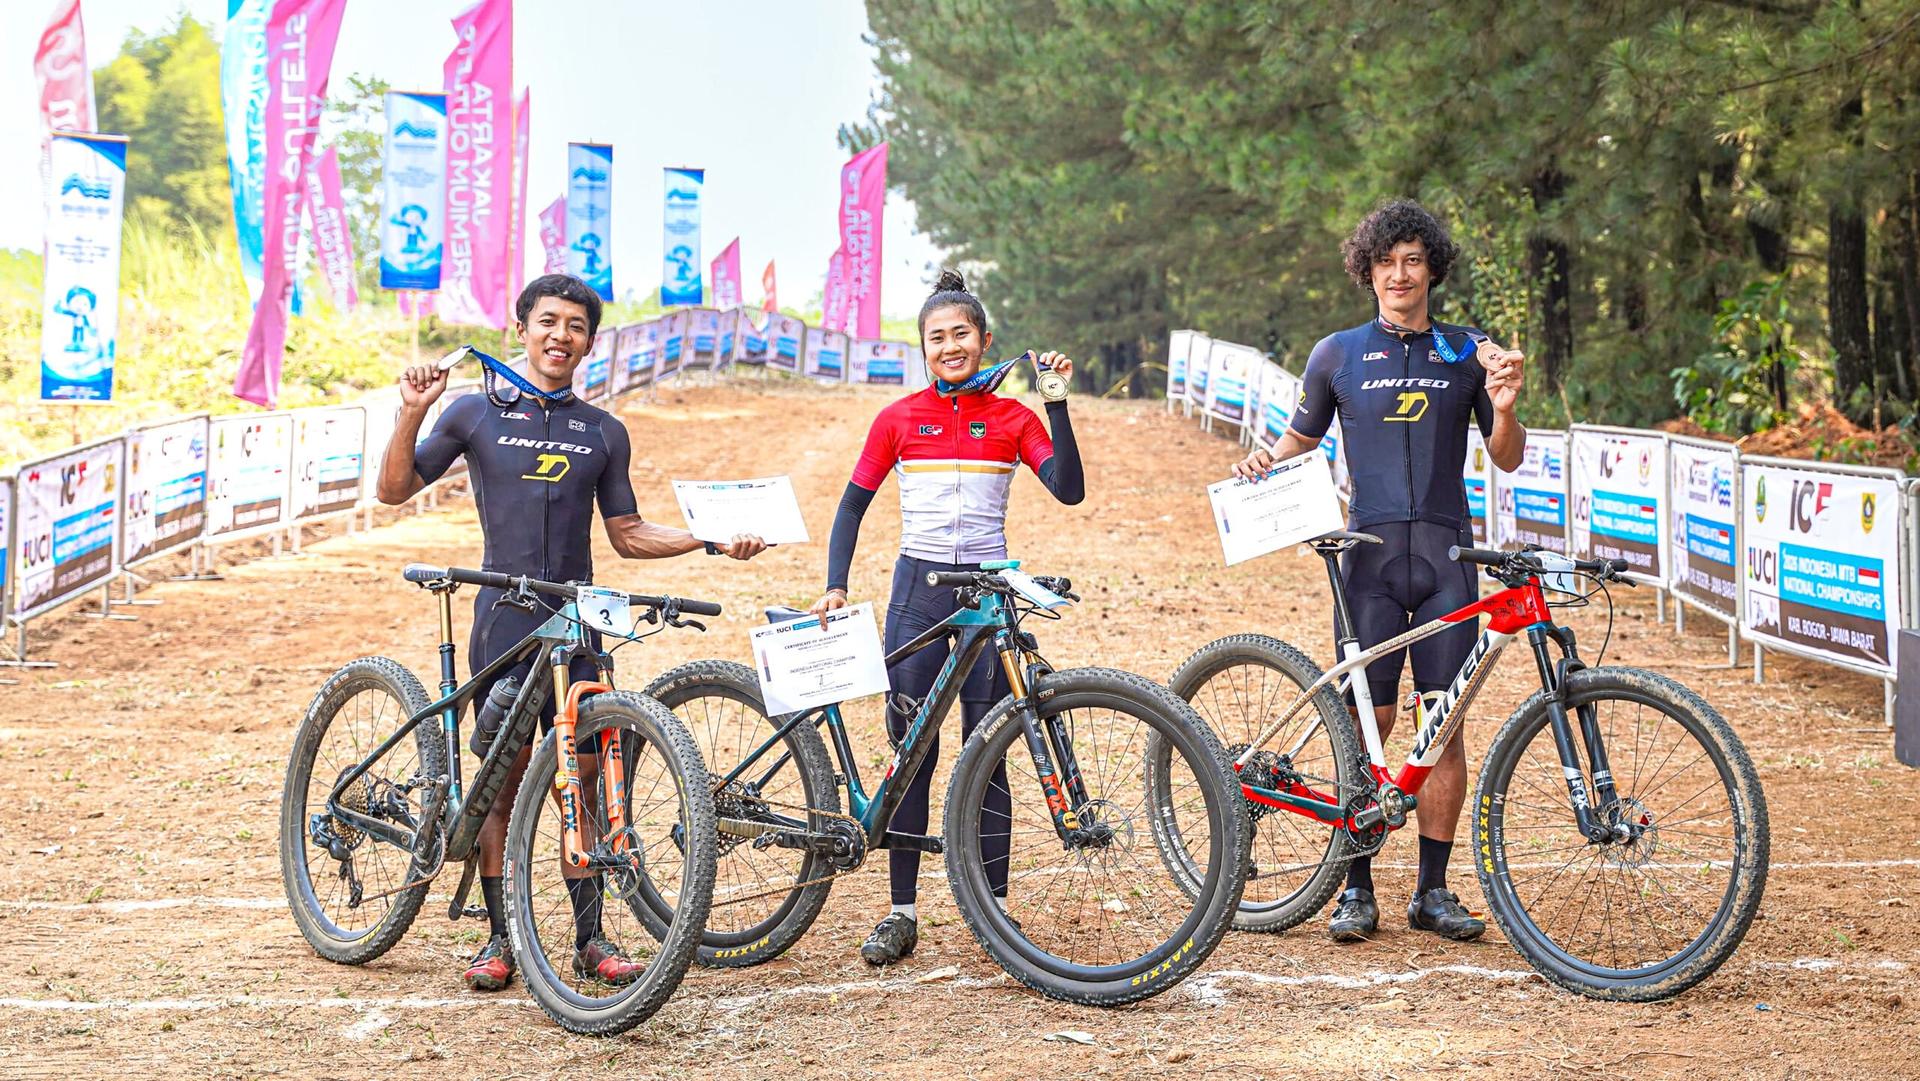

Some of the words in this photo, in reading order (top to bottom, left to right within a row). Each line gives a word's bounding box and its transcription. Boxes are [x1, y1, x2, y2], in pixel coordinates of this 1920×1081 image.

[1361, 377, 1450, 390] UNITED
[497, 435, 593, 455] UNITED
[1799, 558, 1838, 579] INDONESIA
[1838, 566, 1856, 583] MTB
[1783, 576, 1817, 598] NATIONAL
[1817, 582, 1882, 611] CHAMPIONSHIPS
[599, 608, 613, 626] 3
[1802, 620, 1826, 640] BOGOR
[1851, 631, 1876, 651] BARAT
[904, 653, 958, 751] UNITED
[1413, 631, 1490, 761] UNITED
[476, 687, 546, 815] UNITED
[1033, 754, 1046, 764] 32
[1570, 778, 1590, 811] FOX
[561, 792, 579, 834] FOX
[1154, 819, 1181, 872] BARZO
[1479, 795, 1495, 874] MAXXIS
[714, 935, 770, 958] MAXXIS
[1131, 937, 1194, 986] MAXXIS
